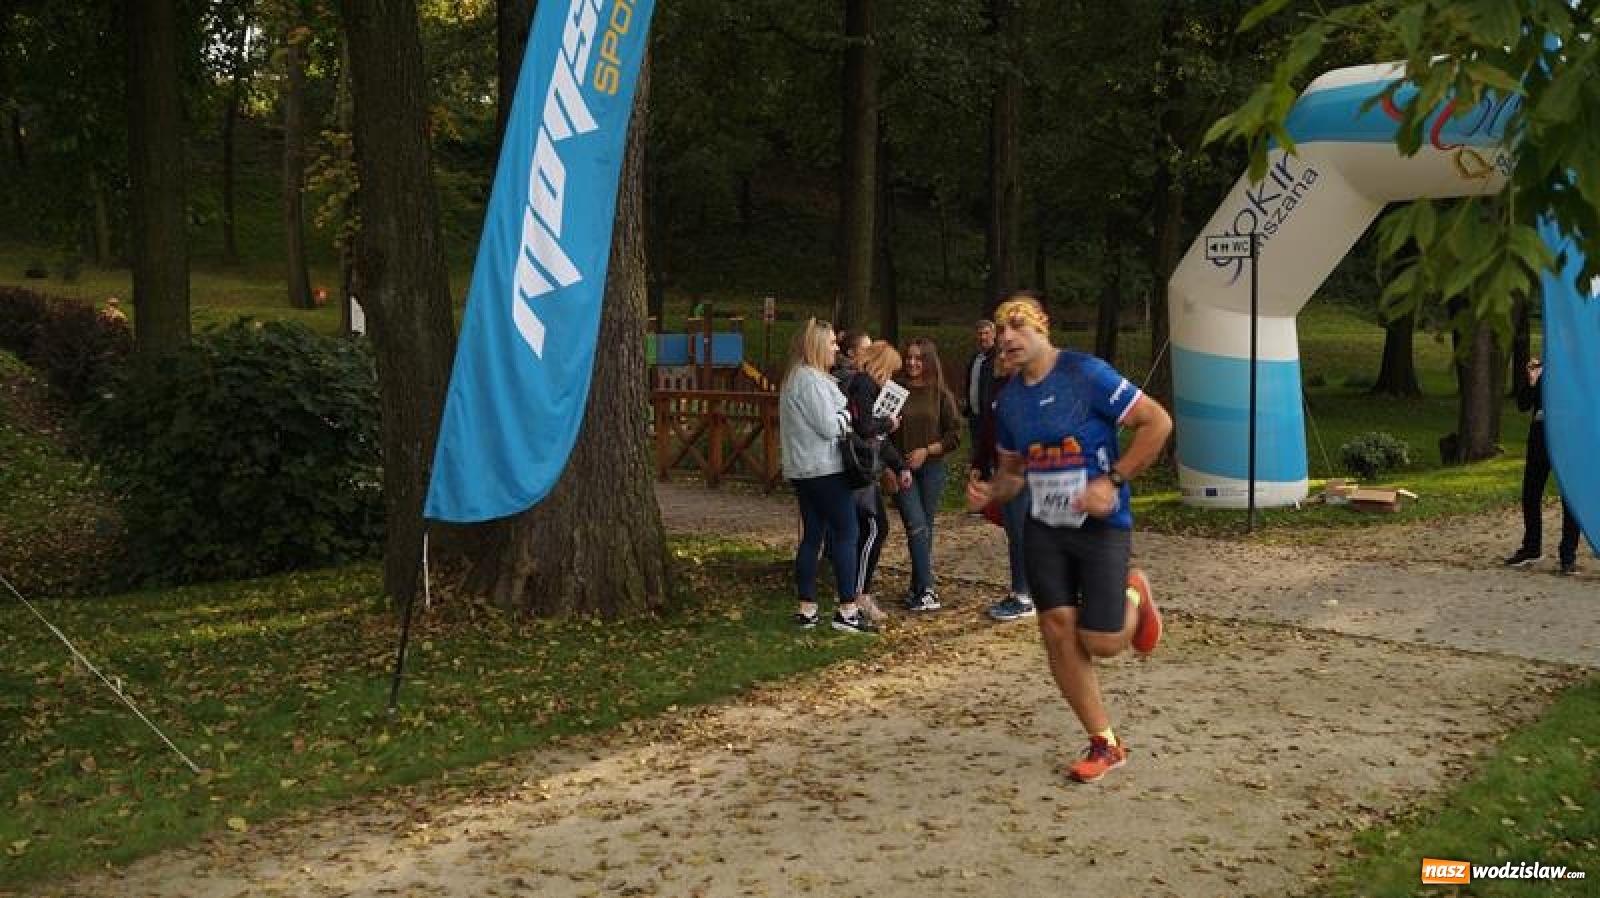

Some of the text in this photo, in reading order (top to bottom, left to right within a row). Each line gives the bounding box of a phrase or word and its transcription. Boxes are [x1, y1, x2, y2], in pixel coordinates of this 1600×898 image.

[593, 0, 637, 96] SPO
[512, 0, 601, 360] MONS
[1231, 240, 1249, 253] WC
